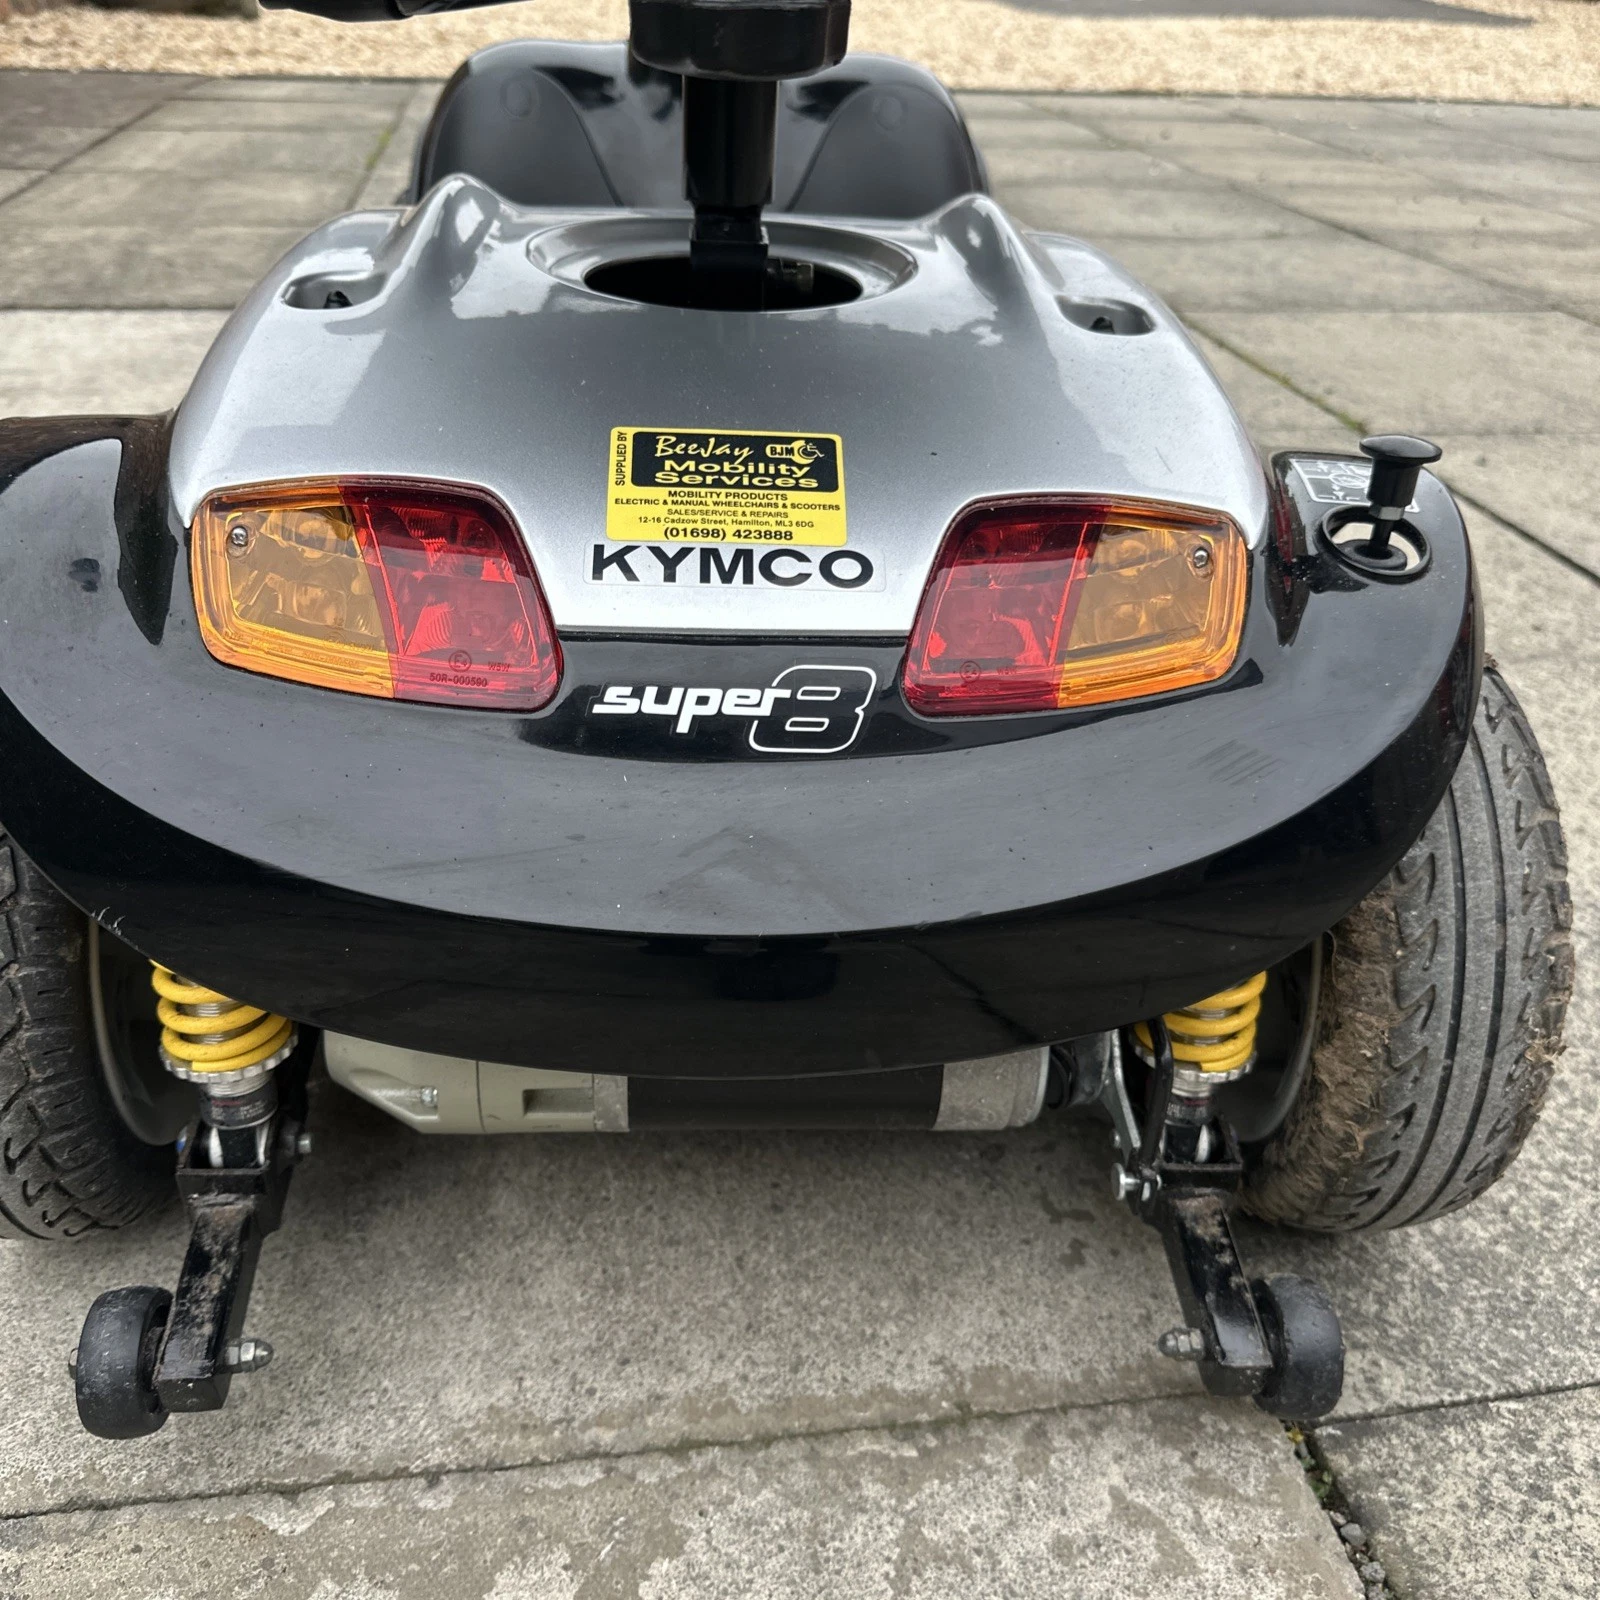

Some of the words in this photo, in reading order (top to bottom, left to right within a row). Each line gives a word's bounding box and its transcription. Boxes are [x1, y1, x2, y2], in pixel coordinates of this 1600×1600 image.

[616, 431, 627, 442] BY
[654, 434, 755, 466] BeeJay
[769, 445, 796, 457] BJM
[614, 443, 627, 487] SUPPLIED
[663, 459, 811, 478] Mobility
[654, 471, 819, 489] Services
[667, 490, 723, 499] MOBILITY
[724, 491, 789, 501] PRODUCTS
[614, 498, 660, 506] ELECTRIC
[662, 498, 669, 506] &
[671, 499, 710, 507] MANUAL
[712, 500, 780, 509] WHEELCHAIRS
[790, 502, 841, 511] SCOOTERS
[667, 508, 739, 517] SALES/SERVICE
[749, 510, 789, 519] REPAIRS
[638, 516, 662, 524] 12-16
[663, 516, 699, 525] Cadzow
[700, 517, 729, 527] Street,
[731, 518, 773, 528] Hamilton,
[775, 520, 794, 528] ML3
[795, 520, 815, 529] 6DG
[663, 526, 727, 542] (01698)
[732, 529, 794, 541] 423888
[592, 544, 874, 589] KYMCO
